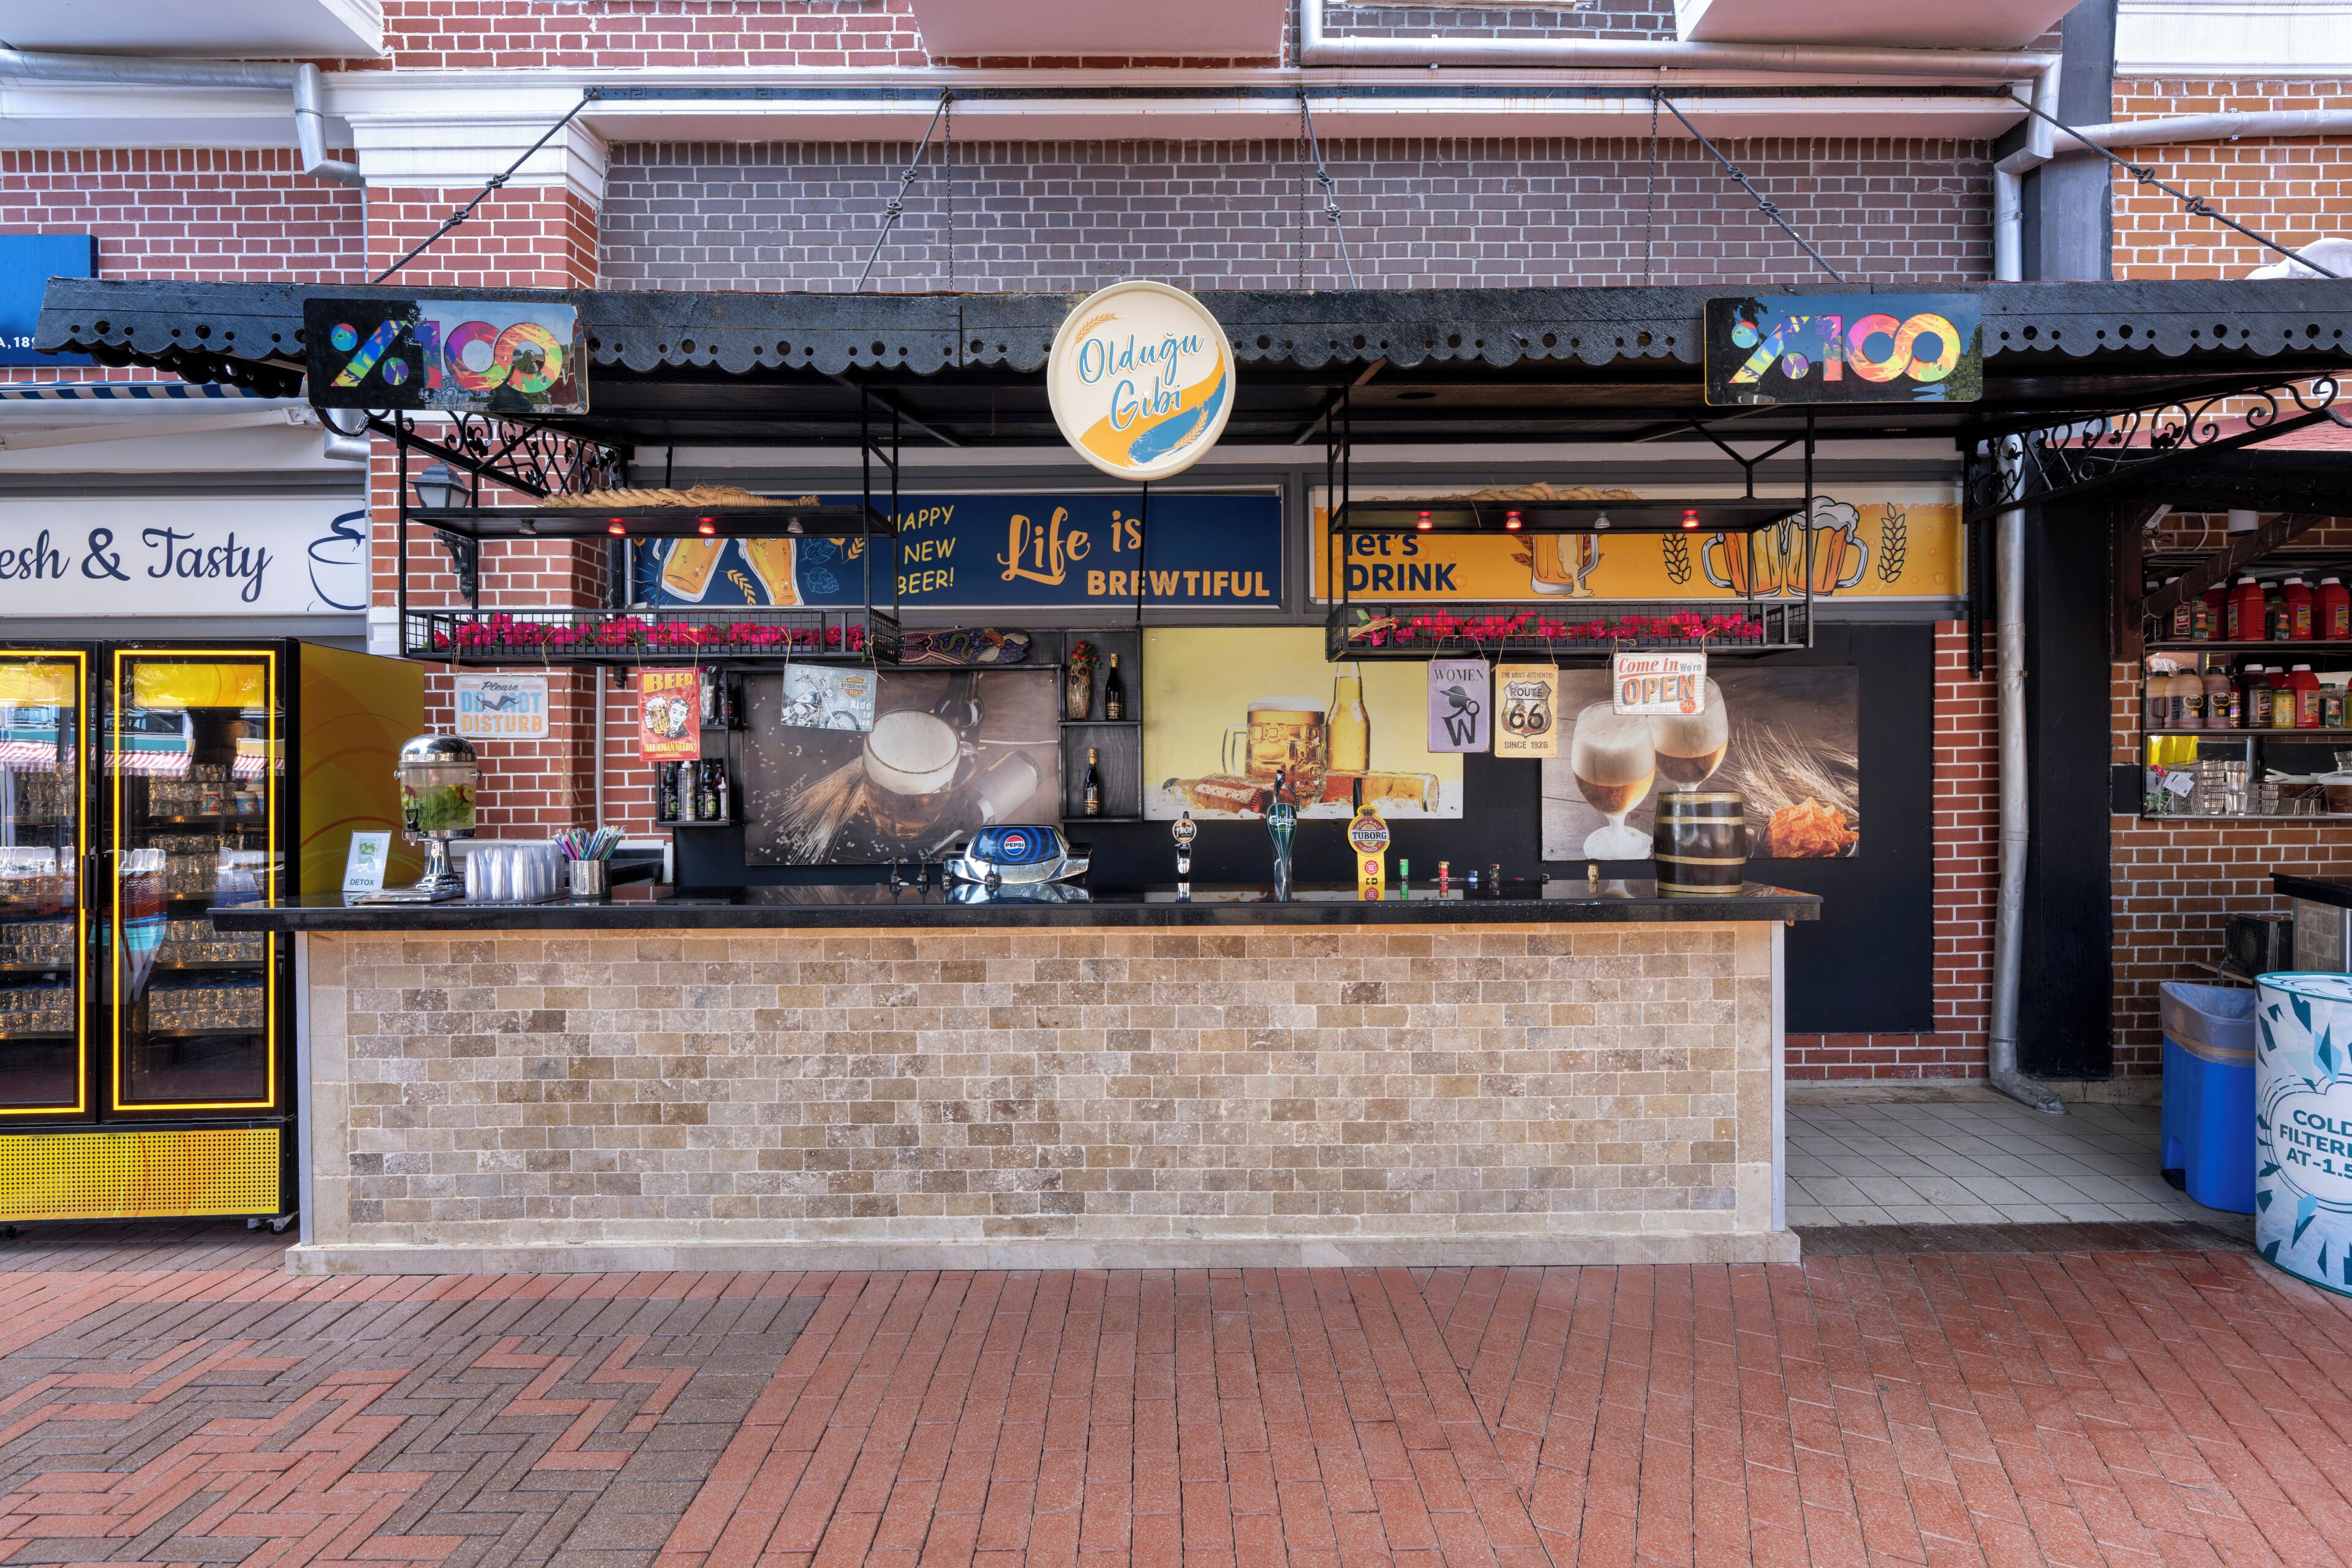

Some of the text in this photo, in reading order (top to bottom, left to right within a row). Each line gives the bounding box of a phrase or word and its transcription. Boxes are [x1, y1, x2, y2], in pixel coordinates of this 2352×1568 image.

[1079, 332, 1204, 388] Olduğu
[1109, 375, 1181, 431] Gibi
[1110, 510, 1142, 552] is
[904, 537, 956, 565] NEW
[997, 507, 1091, 586] Life
[81, 527, 130, 581] &
[142, 526, 273, 603] Tasty
[898, 567, 954, 595] BEER!
[1087, 570, 1270, 597] BREWTIFUL
[1348, 563, 1457, 592] DRINK
[1434, 669, 1484, 681] WOMEN
[1619, 658, 1659, 673] Come
[1663, 657, 1679, 672] in
[481, 681, 519, 692] Please
[643, 673, 693, 694] BEER
[1510, 687, 1543, 697] ROUTE
[1622, 674, 1695, 705] OPEN
[461, 691, 542, 713] DO NOT
[850, 699, 872, 710] Ride
[461, 714, 543, 733] DISTURB
[1509, 703, 1544, 729] 66
[675, 742, 694, 752] NEEDS
[1504, 741, 1548, 749] SINCE 1926
[1268, 815, 1297, 825] Carlsberg
[1368, 820, 1381, 829] MALT
[1352, 831, 1387, 840] TUBORG
[2293, 1109, 2352, 1137] COLD
[2286, 1147, 2312, 1167] AT
